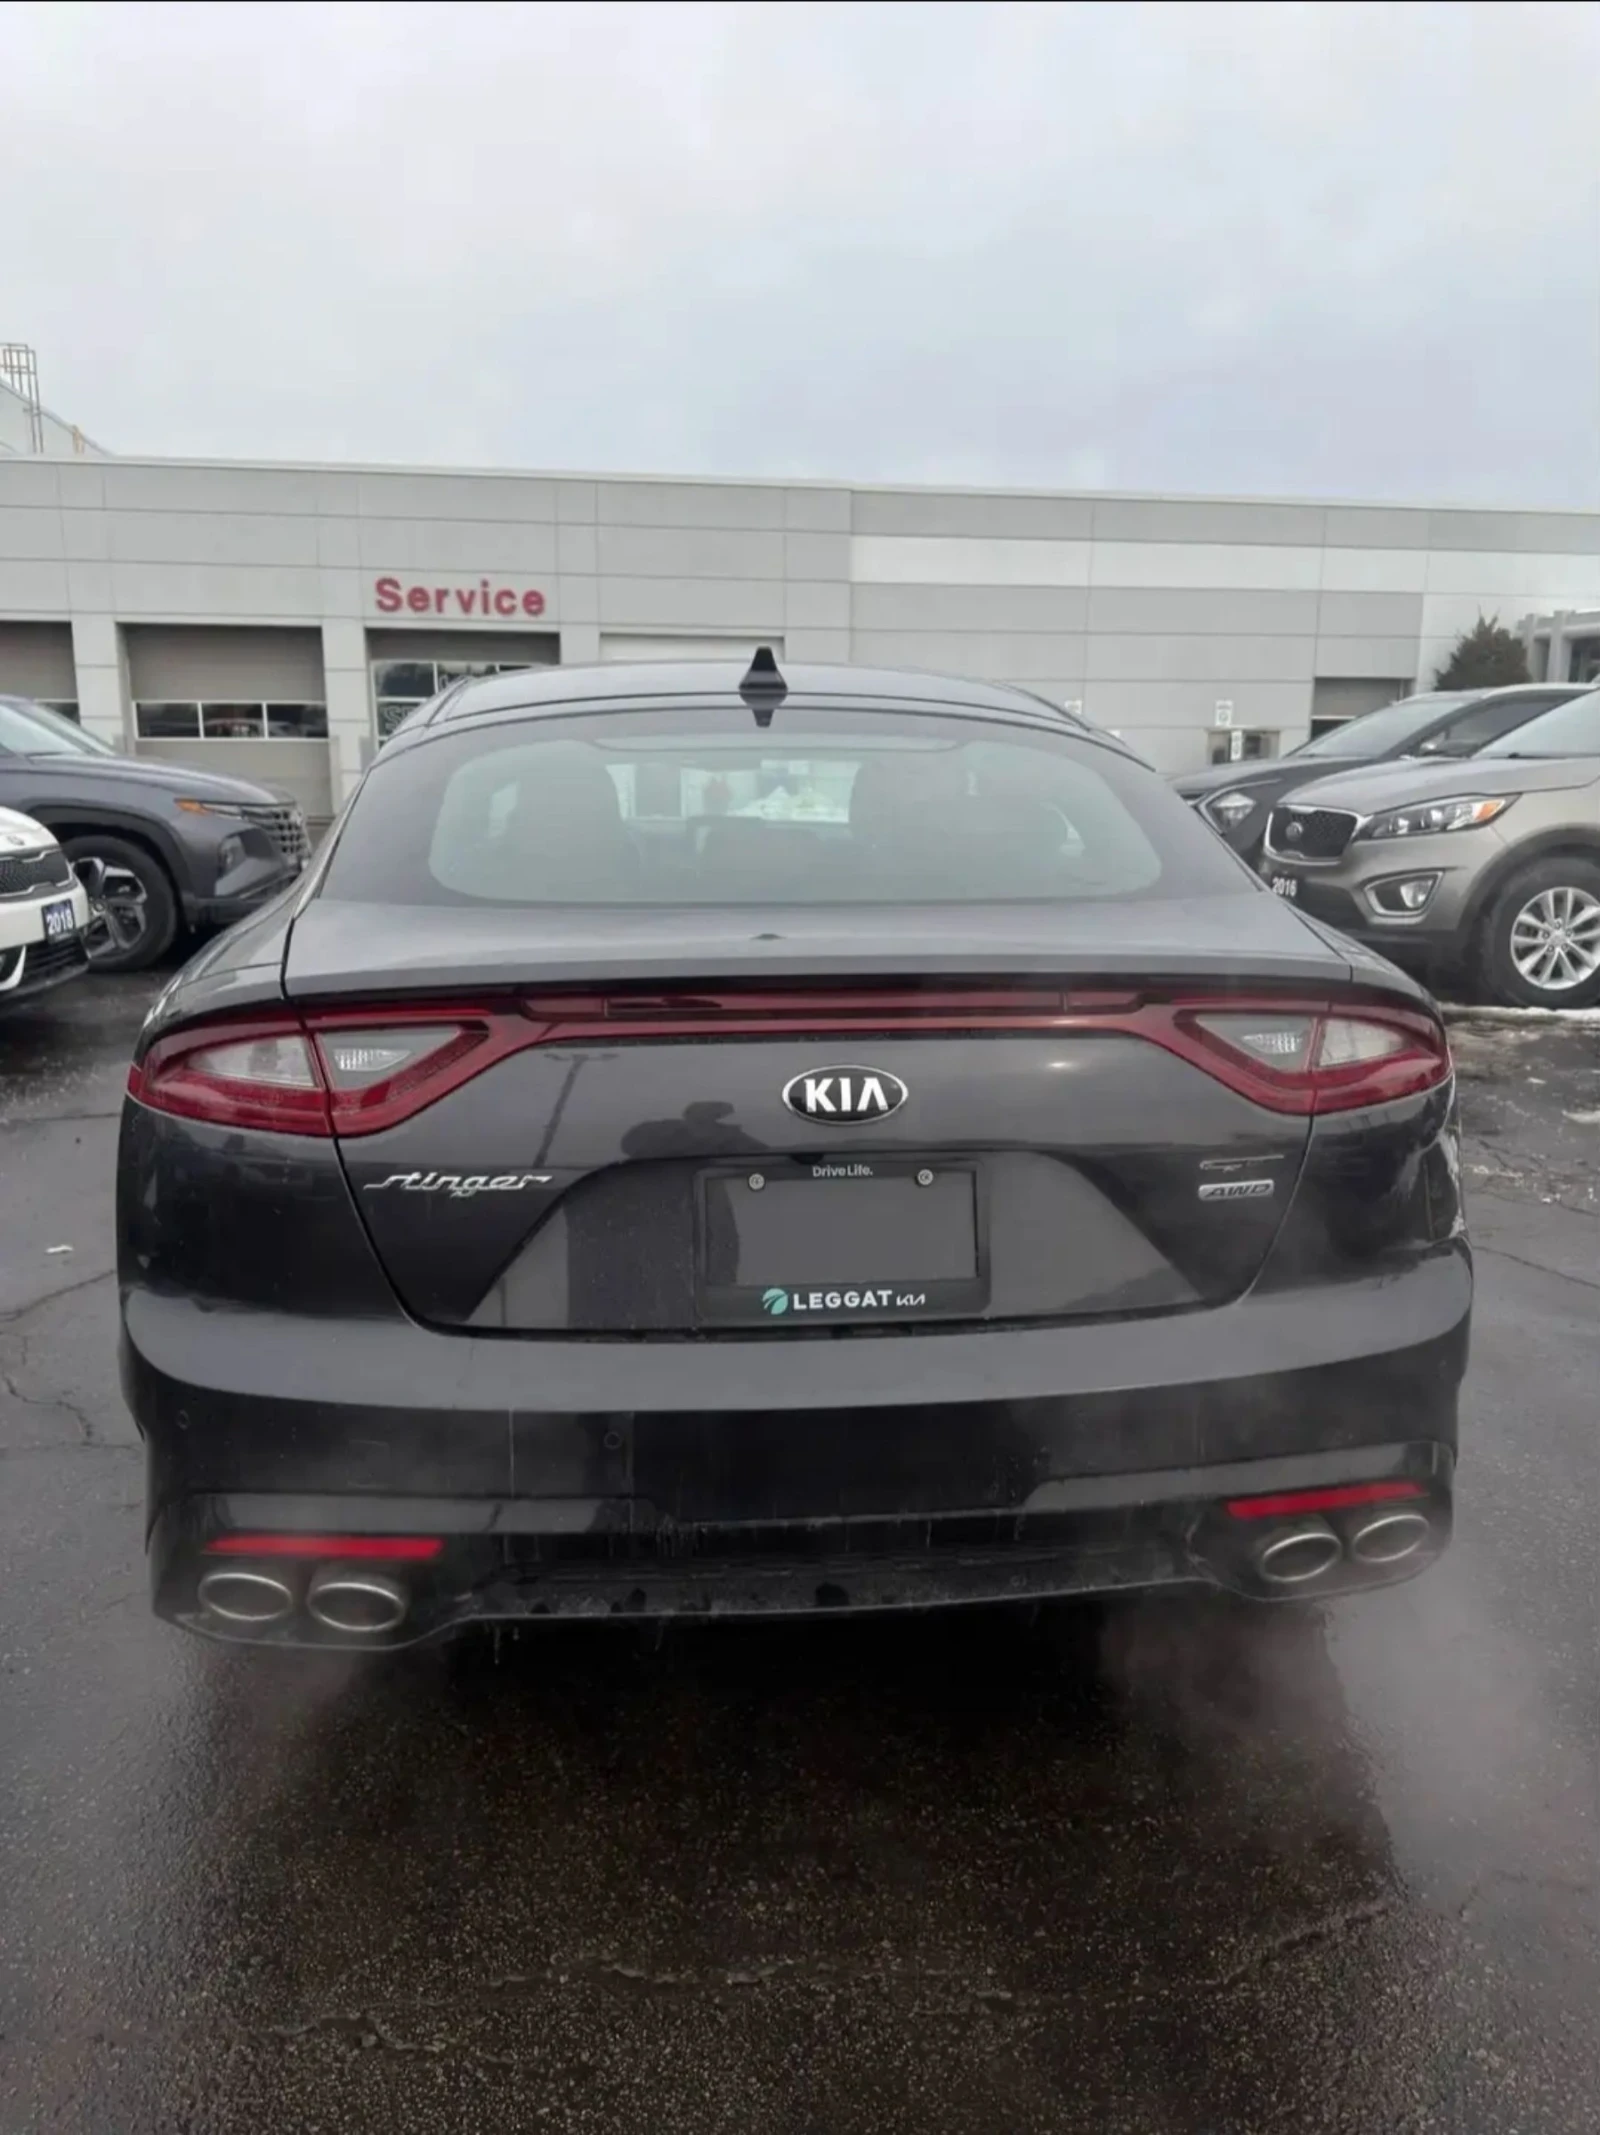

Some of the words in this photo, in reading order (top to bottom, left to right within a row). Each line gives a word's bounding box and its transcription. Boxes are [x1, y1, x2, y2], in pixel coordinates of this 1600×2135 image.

[375, 577, 545, 615] Service
[46, 908, 74, 934] 2018
[804, 1077, 889, 1112] KIA
[812, 1165, 846, 1178] Drive
[1205, 1182, 1271, 1197] AWD
[793, 1290, 893, 1311] LEGGAT
